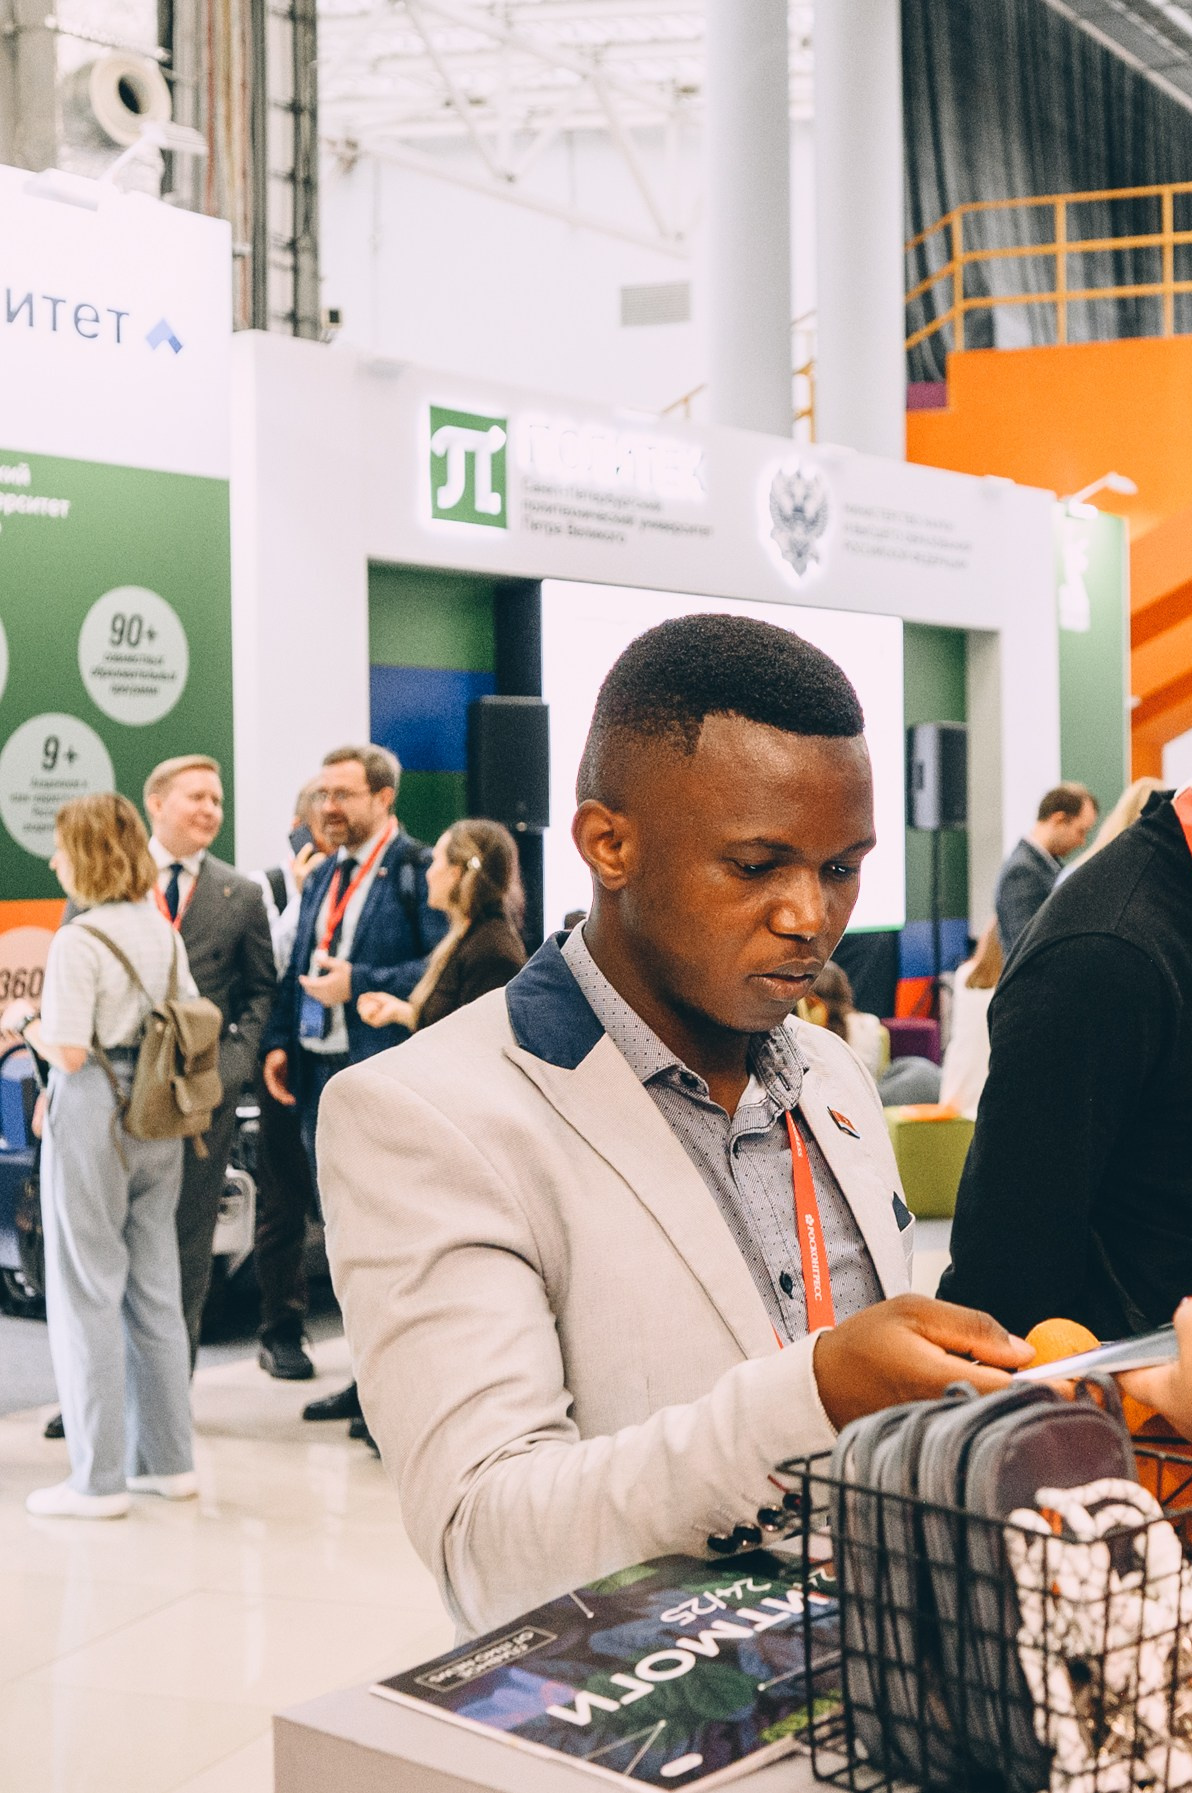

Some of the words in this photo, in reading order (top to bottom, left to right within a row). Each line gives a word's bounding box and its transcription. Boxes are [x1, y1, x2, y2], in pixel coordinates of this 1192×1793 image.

[6, 288, 130, 343] итет
[110, 612, 158, 648] 90+
[806, 1225, 823, 1302] РОСКОНГРЕСС
[660, 1577, 773, 1626] 24/25
[546, 1588, 830, 1727] ИТМОГИ
